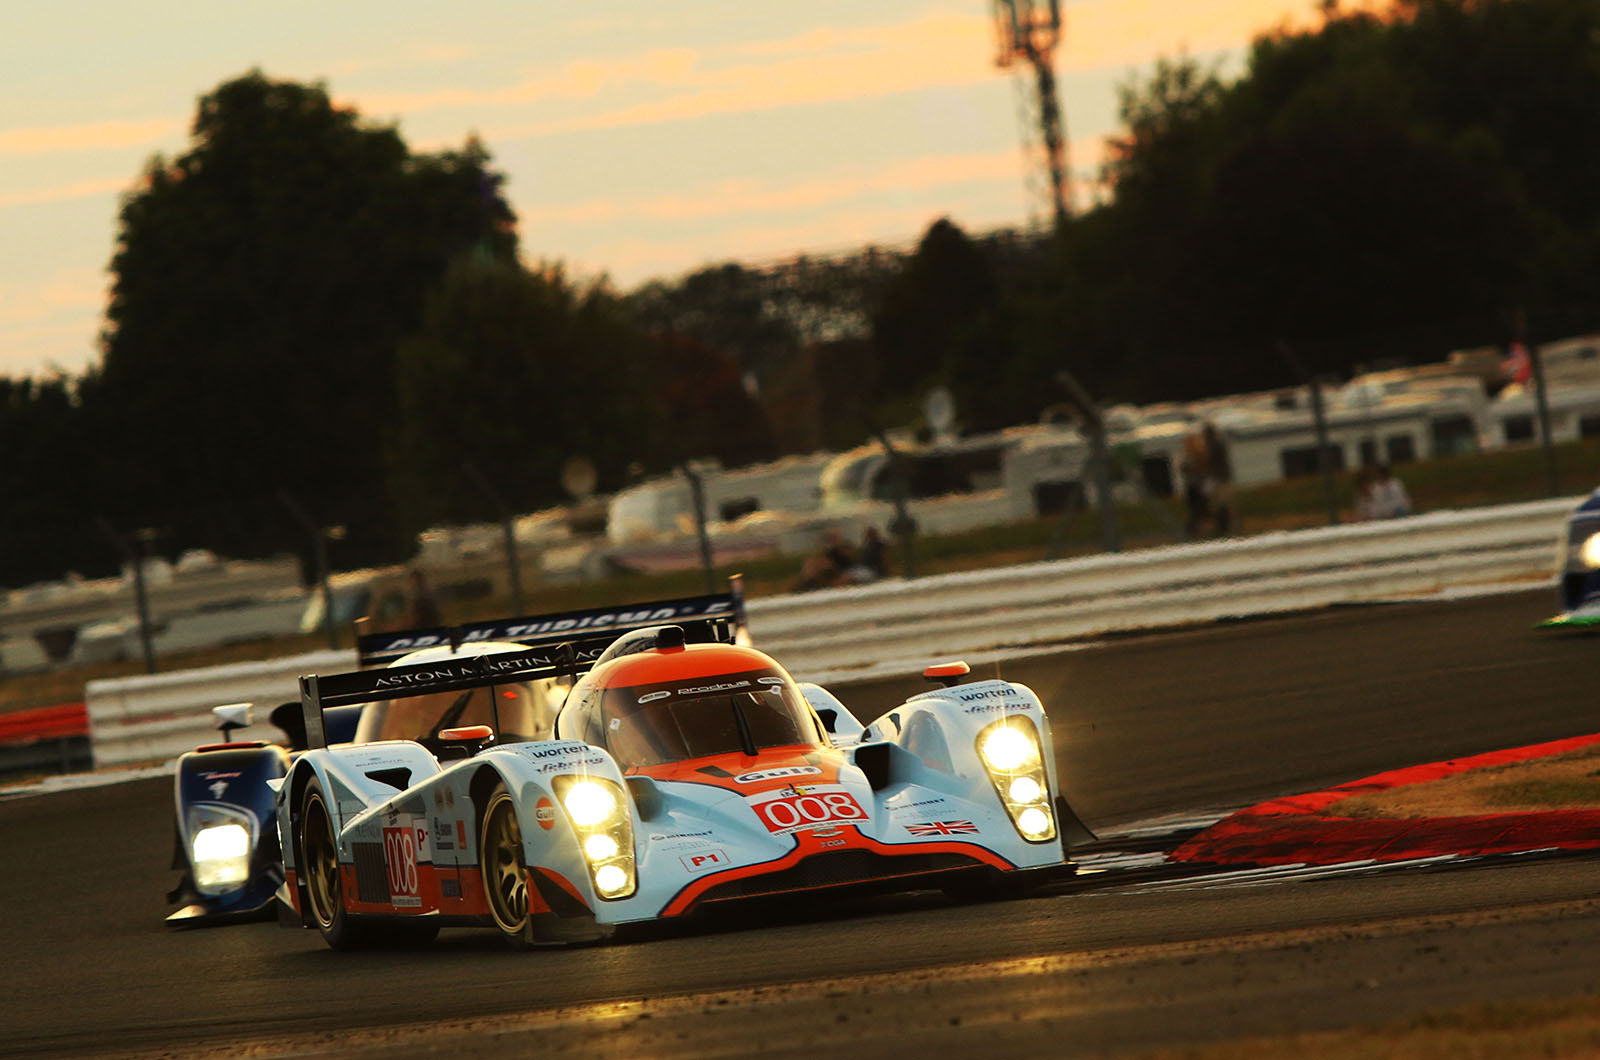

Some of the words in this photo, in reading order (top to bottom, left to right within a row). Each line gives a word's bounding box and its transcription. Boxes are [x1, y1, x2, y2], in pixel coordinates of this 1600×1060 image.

[375, 668, 453, 688] ASTON
[960, 687, 1017, 702] worten
[532, 744, 590, 759] worten
[738, 766, 817, 781] Gulf
[536, 807, 555, 820] Gulf
[764, 794, 862, 828] 008
[387, 831, 418, 895] 008
[690, 853, 719, 867] P1
